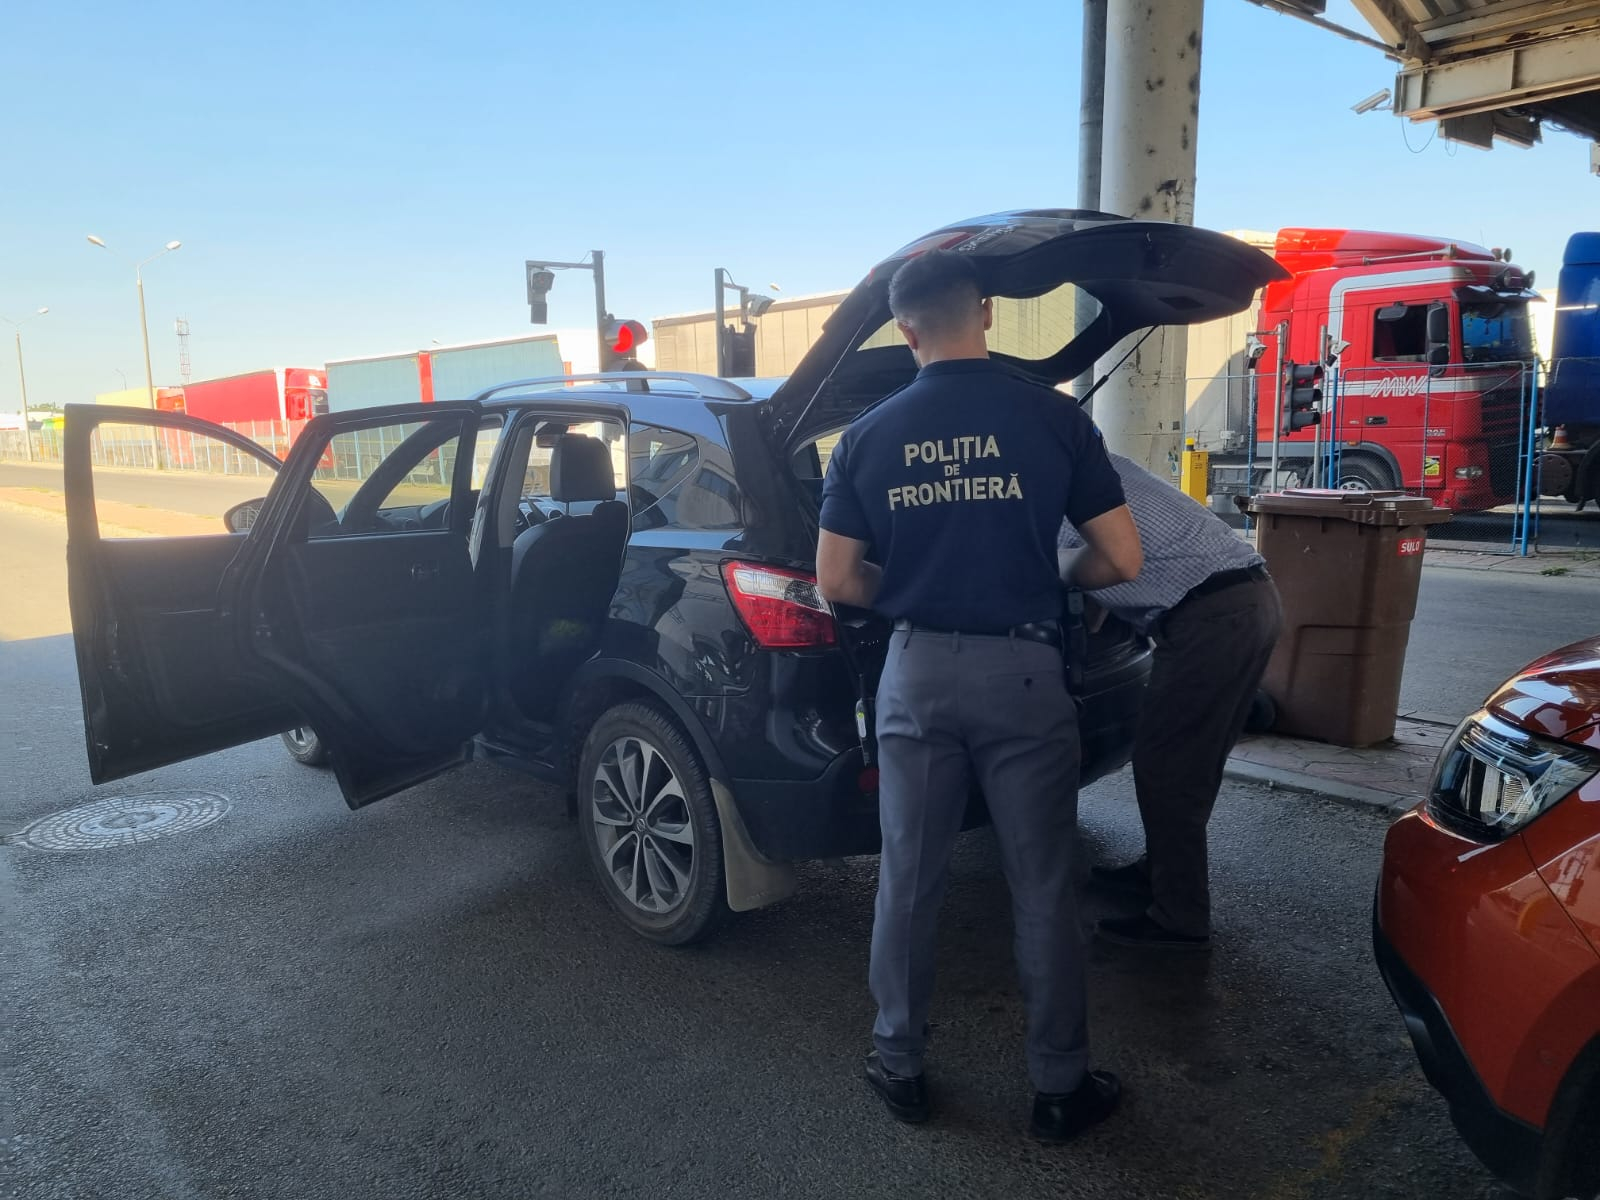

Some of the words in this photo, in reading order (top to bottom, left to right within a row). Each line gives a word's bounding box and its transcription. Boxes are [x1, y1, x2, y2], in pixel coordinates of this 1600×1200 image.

[904, 435, 1000, 466] POLIȚIA
[944, 464, 960, 477] DE
[888, 473, 1022, 511] FRONTIERĂ
[1400, 541, 1420, 553] SULO
